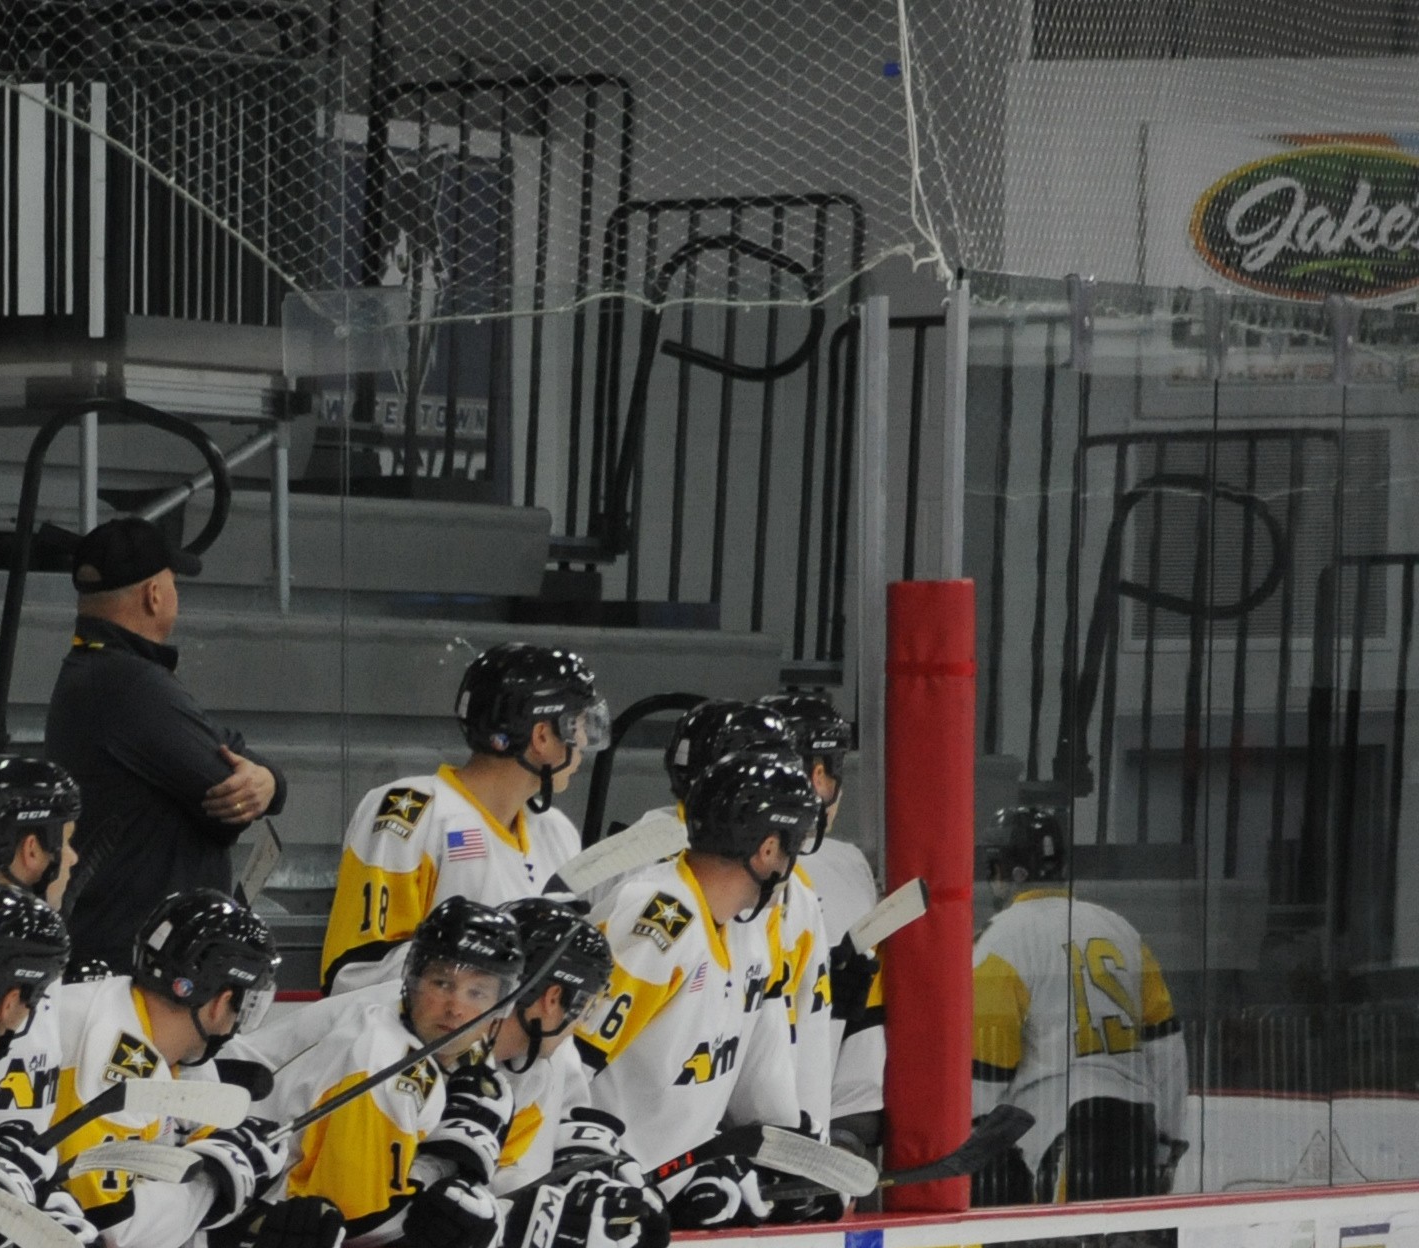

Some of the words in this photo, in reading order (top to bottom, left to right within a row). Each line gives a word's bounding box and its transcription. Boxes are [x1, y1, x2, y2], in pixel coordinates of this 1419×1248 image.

[1226, 176, 1419, 272] Jake
[17, 810, 51, 820] CCM
[359, 882, 390, 936] 18
[14, 969, 45, 978] CCM
